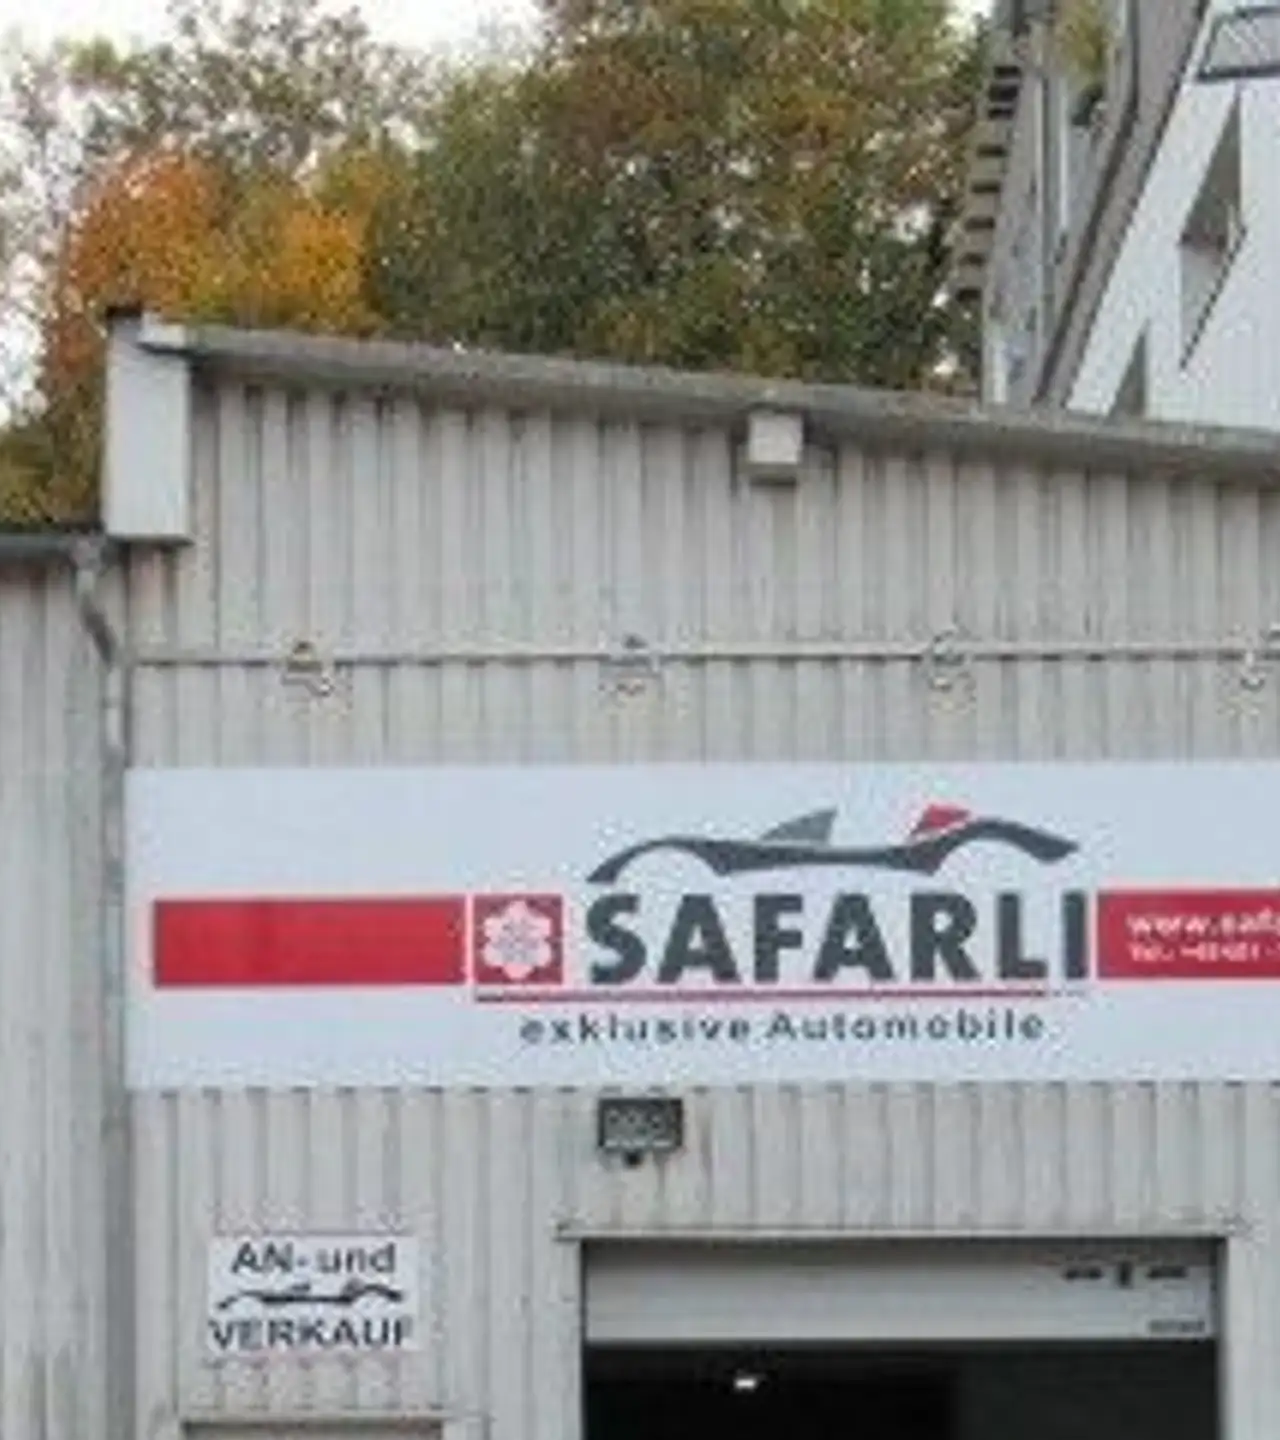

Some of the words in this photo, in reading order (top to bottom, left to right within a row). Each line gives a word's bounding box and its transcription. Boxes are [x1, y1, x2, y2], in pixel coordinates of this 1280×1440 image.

[586, 893, 1088, 985] SAFARLI
[520, 1014, 752, 1043] exklusive
[765, 1010, 1045, 1042] Automobile
[231, 1242, 308, 1273] AN-
[316, 1242, 397, 1273] und
[208, 1316, 414, 1349] VERKAUF
